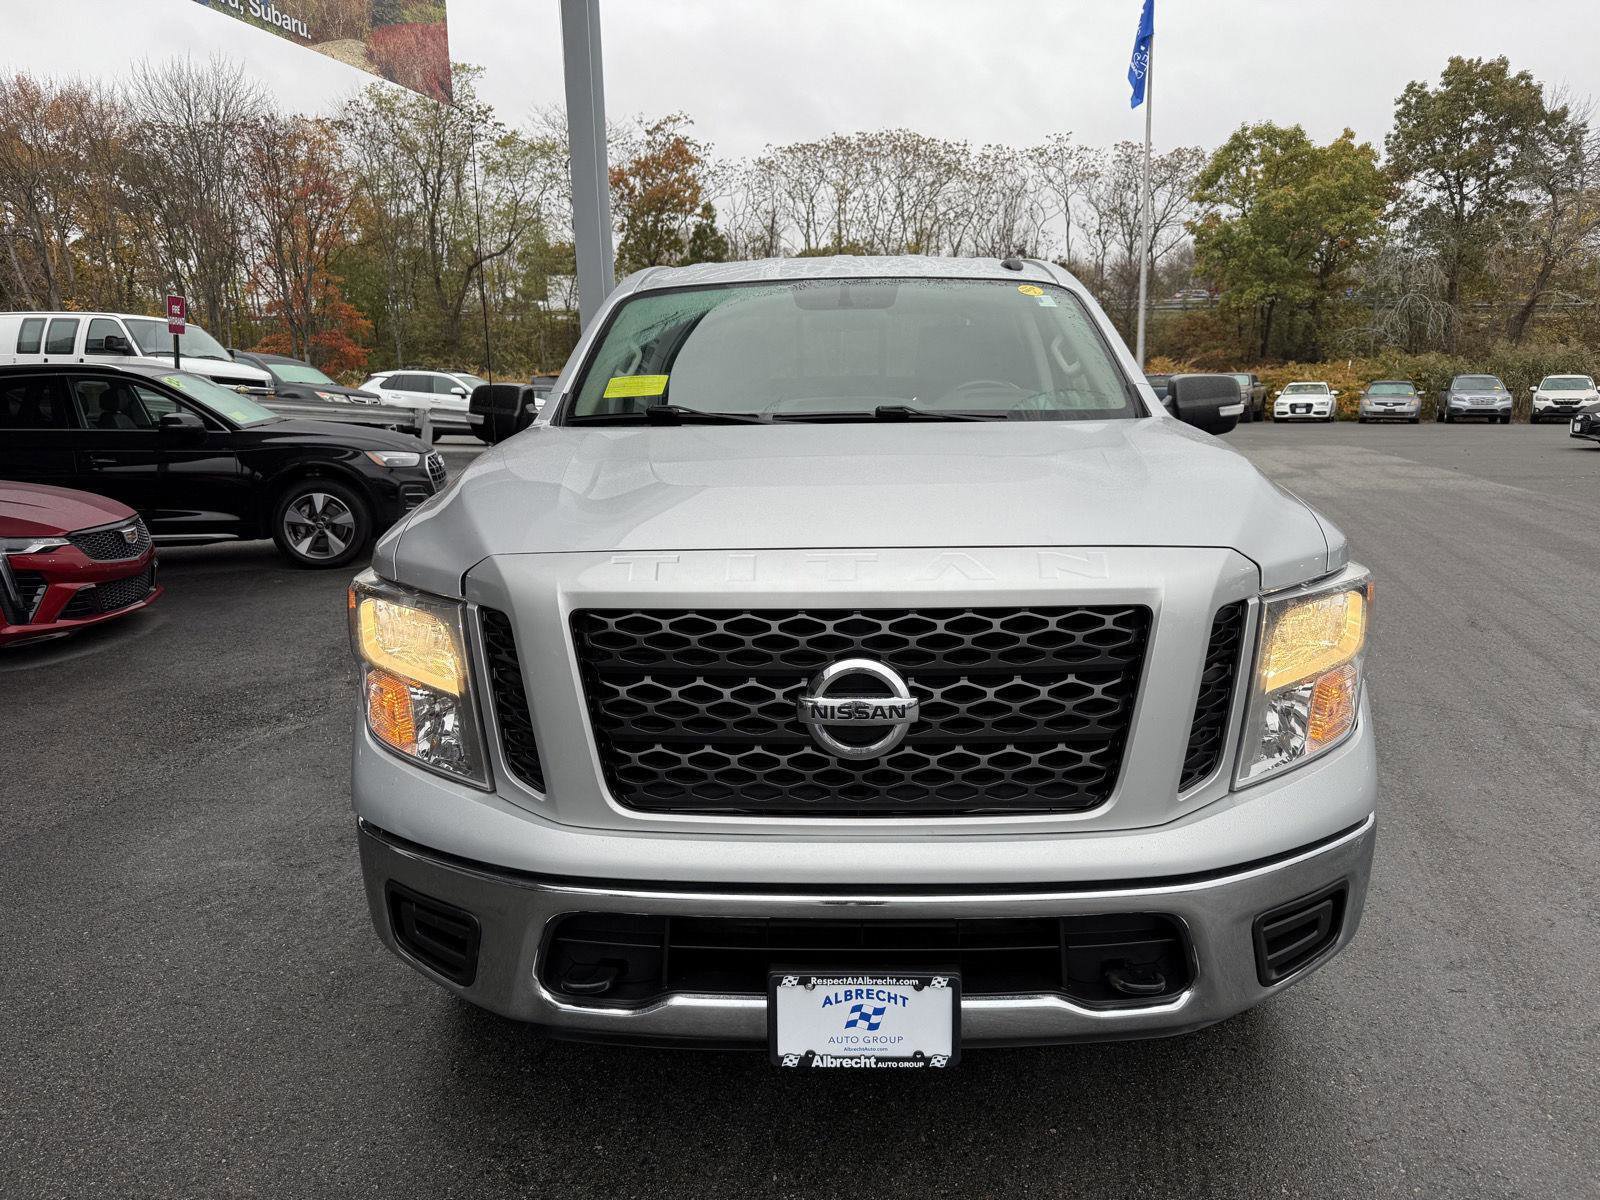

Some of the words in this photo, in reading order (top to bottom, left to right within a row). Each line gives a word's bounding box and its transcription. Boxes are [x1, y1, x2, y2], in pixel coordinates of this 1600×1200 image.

[249, 0, 311, 39] Subaru.
[610, 551, 1109, 582] TITAN
[810, 704, 906, 720] NISSAN
[810, 977, 919, 986] RespectAtAlbrecht.com
[822, 988, 909, 1008] ALBRECHT
[828, 1036, 859, 1044] AUTO
[863, 1036, 904, 1044] GROUP
[811, 1055, 877, 1068] Albrecht
